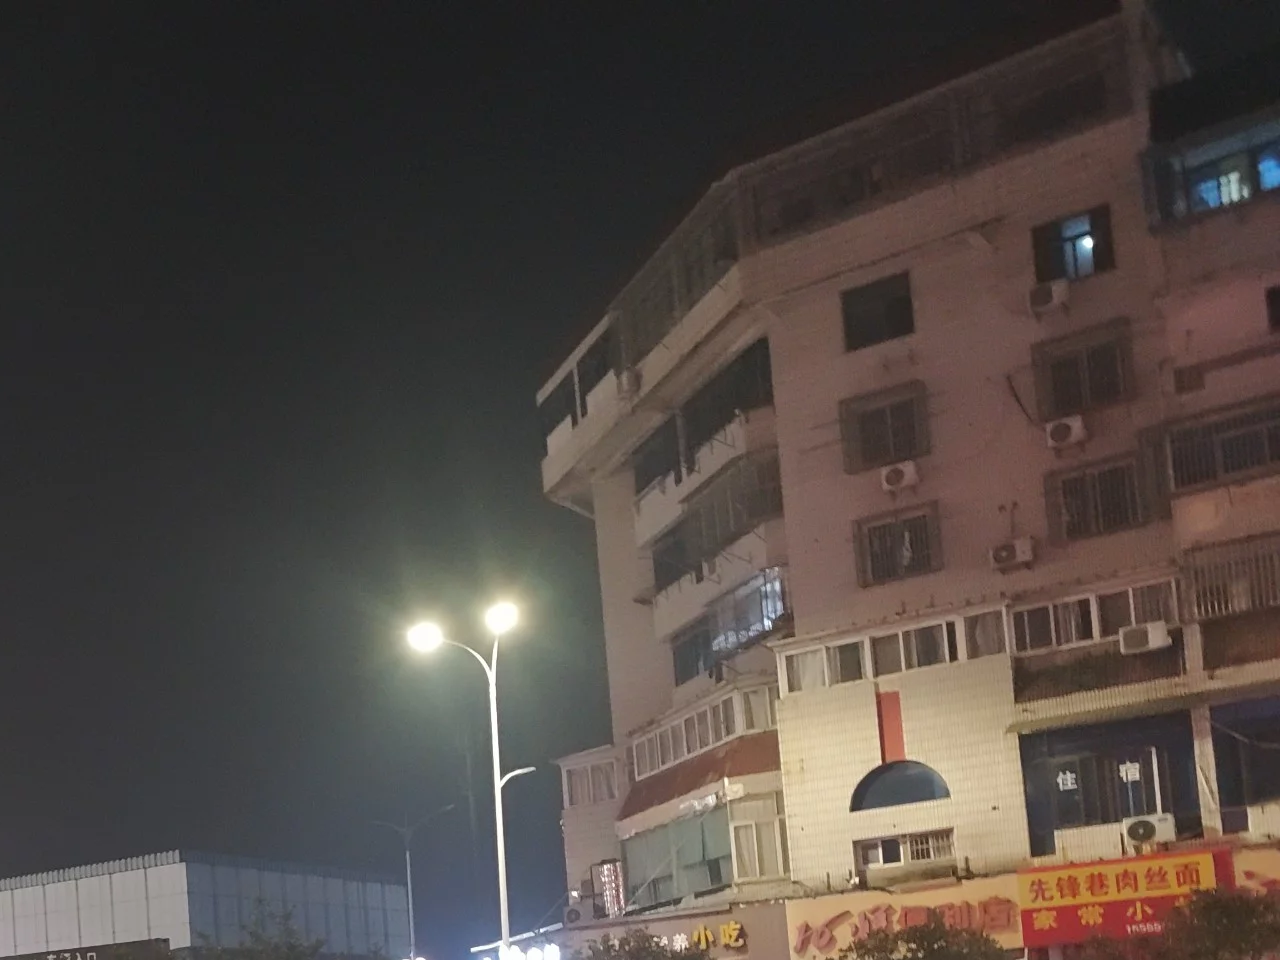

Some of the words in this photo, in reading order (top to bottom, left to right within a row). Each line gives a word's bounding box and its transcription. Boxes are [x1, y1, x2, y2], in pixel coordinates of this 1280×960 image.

[1029, 861, 1201, 903] 先锋巷肉丝面
[1032, 897, 1190, 931] 家常小
